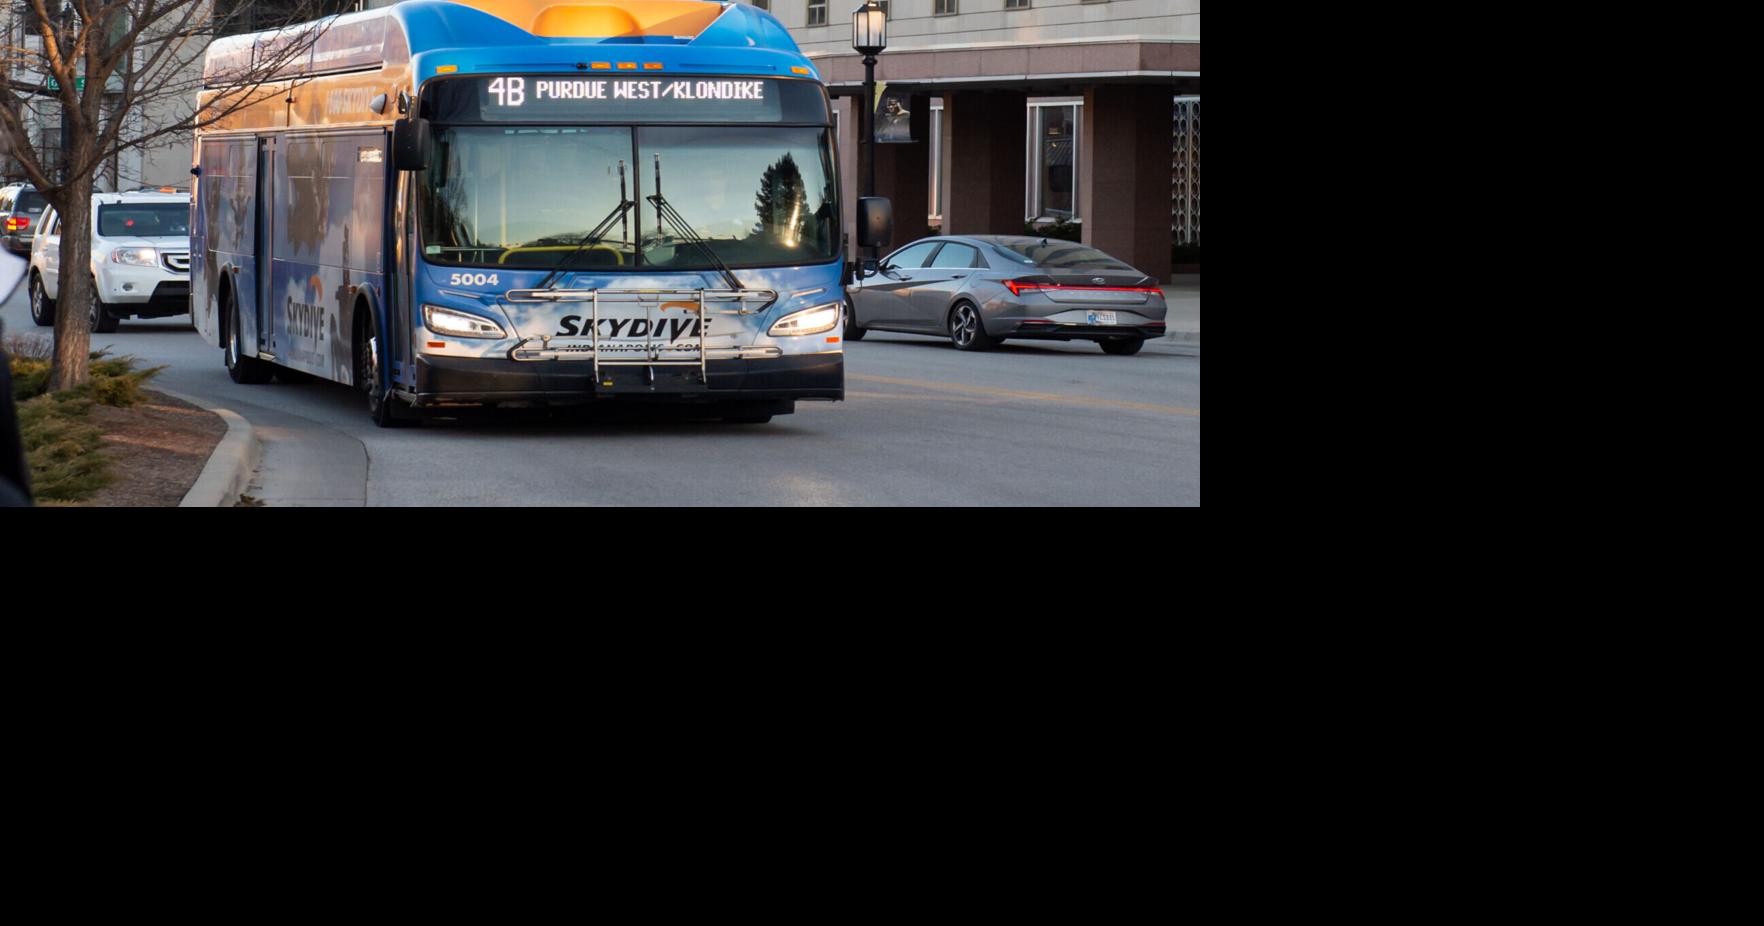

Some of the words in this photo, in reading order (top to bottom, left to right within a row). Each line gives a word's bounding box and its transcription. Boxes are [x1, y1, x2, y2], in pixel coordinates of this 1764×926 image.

[487, 77, 525, 107] 4B
[536, 81, 607, 99] PURDUE
[613, 81, 764, 99] WEST/KLONDIKE
[450, 273, 499, 286] 5004
[286, 295, 325, 352] SKYDIVE
[556, 314, 712, 344] SKYDIVE
